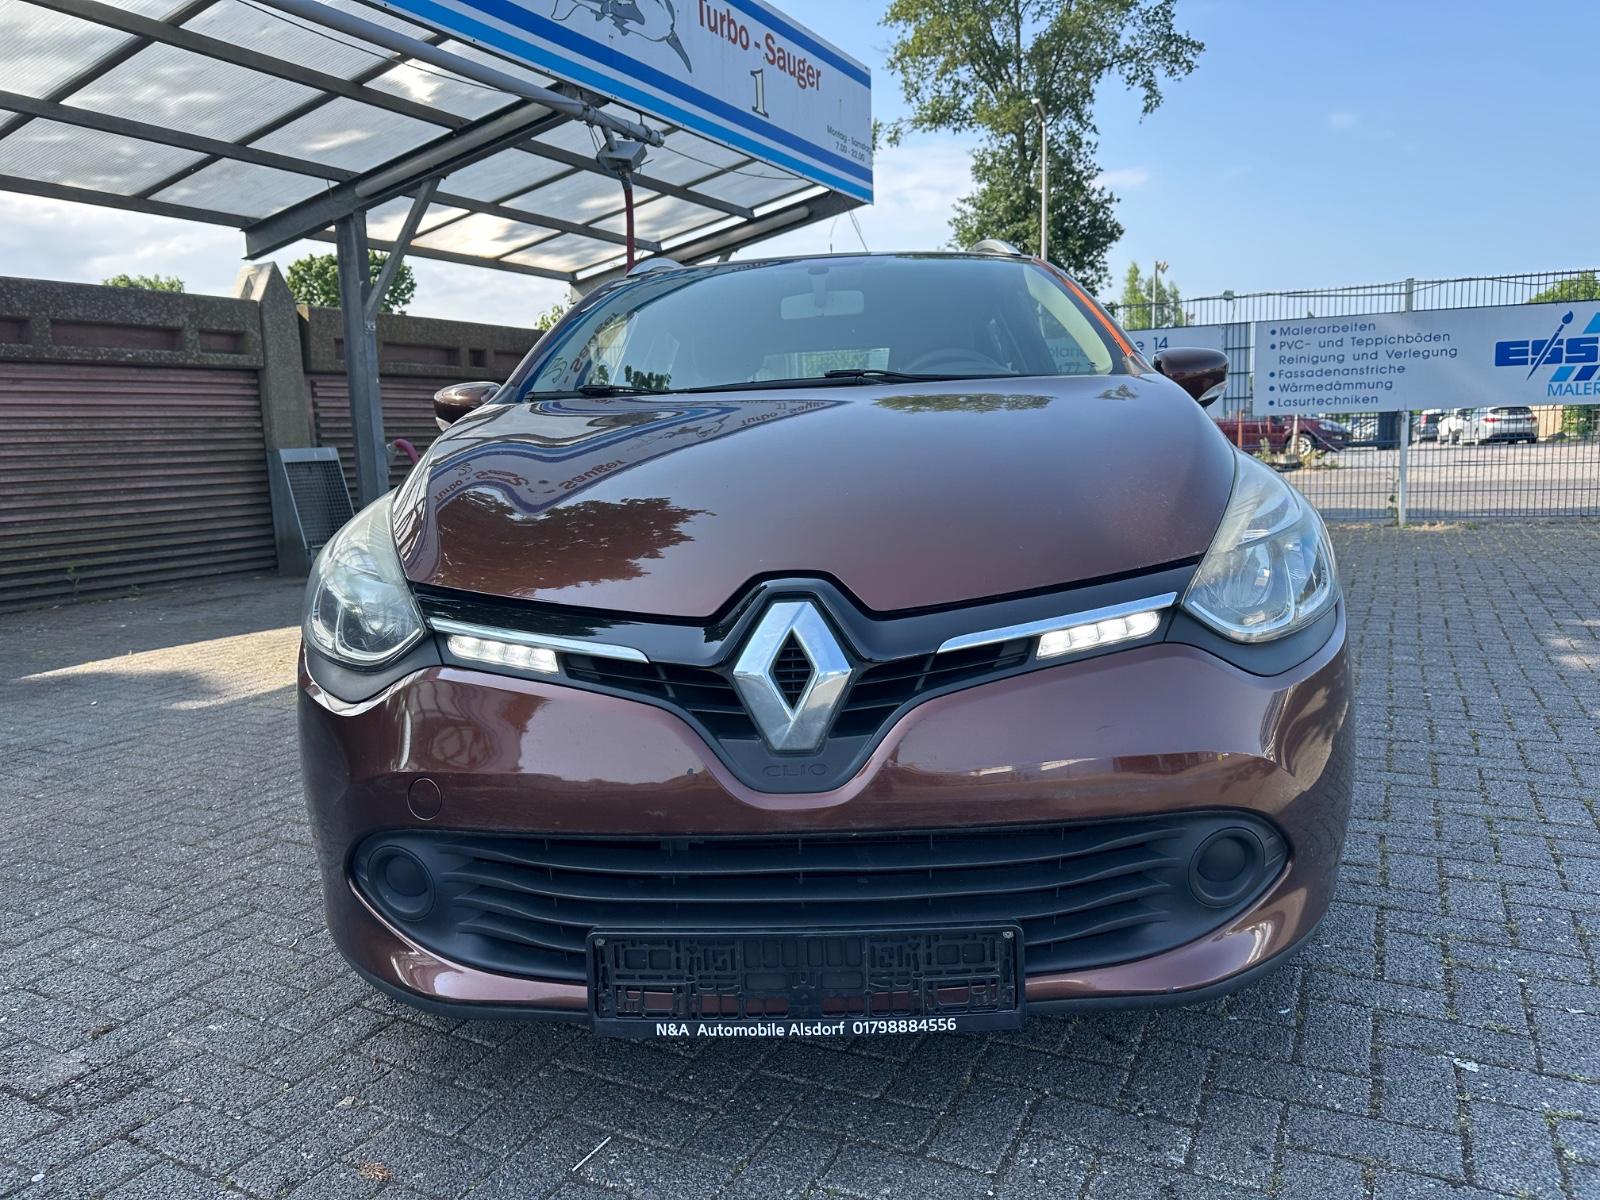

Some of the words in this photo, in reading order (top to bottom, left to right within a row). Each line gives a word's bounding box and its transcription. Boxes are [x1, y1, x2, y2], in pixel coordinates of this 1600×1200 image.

[698, 0, 750, 51] Turbo
[764, 32, 822, 91] Sauger
[750, 68, 769, 118] 1
[1279, 322, 1376, 337] Malerarbeiten
[1153, 336, 1169, 350] 14
[1279, 339, 1311, 351] PVC-
[1318, 337, 1344, 349] und
[1351, 332, 1451, 348] Teppichböden
[1279, 352, 1345, 366] Reinigung
[1352, 350, 1378, 361] und
[1386, 347, 1458, 360] Verlegung
[1278, 364, 1406, 380] Fassadenanstriche
[1279, 380, 1393, 393] Wärmedämmung
[1277, 395, 1379, 408] Lasurtechniken
[763, 763, 829, 777] CLIO
[655, 1023, 690, 1037] N&A
[697, 1022, 785, 1037] Automobile
[788, 1021, 845, 1037] Alsdorf
[852, 1018, 957, 1035] 01798884556
